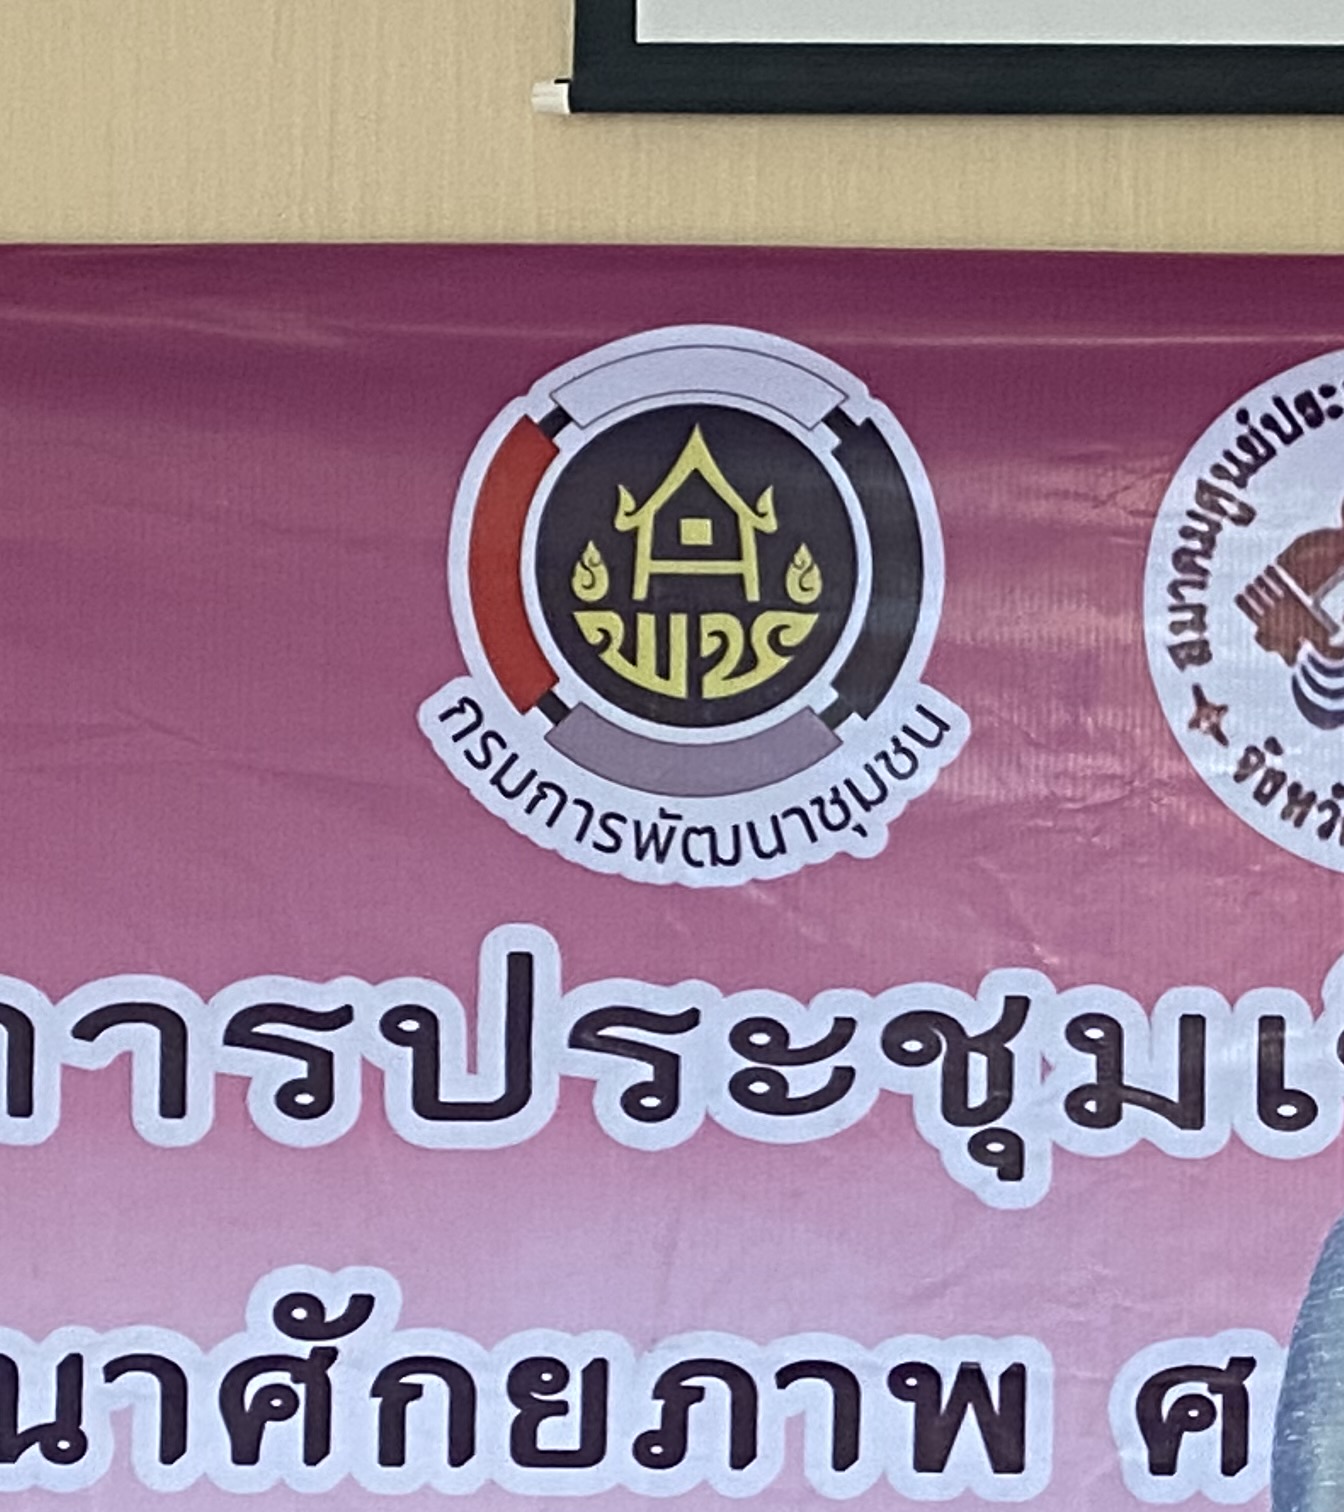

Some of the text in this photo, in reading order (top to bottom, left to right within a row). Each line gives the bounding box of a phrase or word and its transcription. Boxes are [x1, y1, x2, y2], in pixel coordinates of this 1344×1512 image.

[437, 696, 951, 869] กรมการพัฒนาชุมชน
